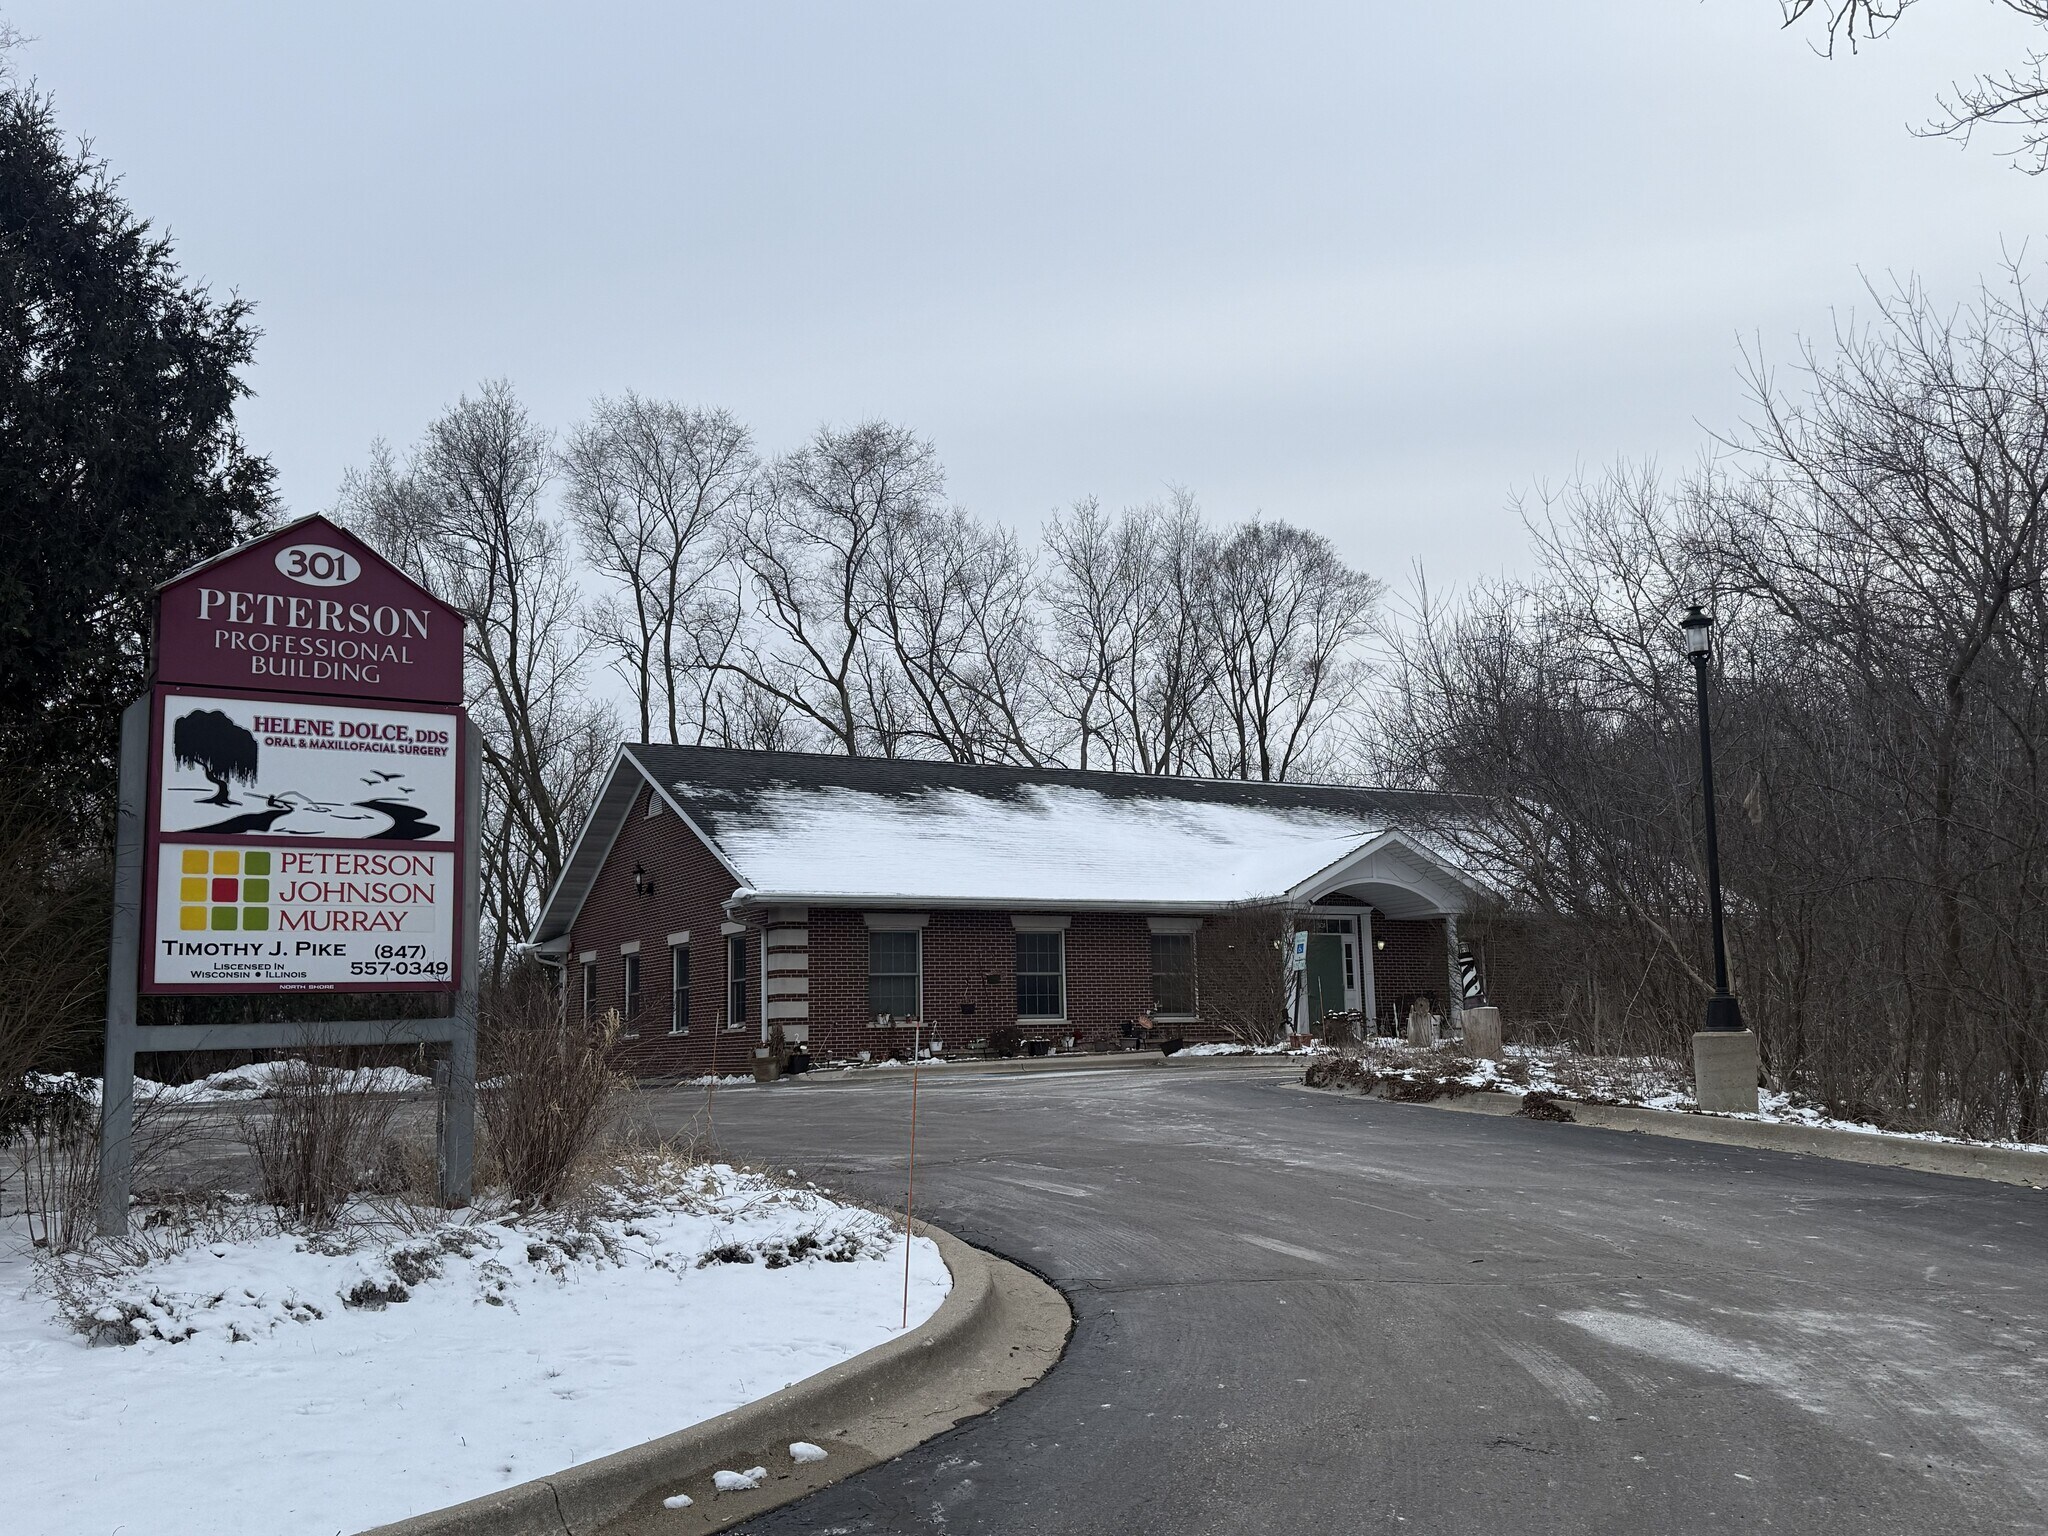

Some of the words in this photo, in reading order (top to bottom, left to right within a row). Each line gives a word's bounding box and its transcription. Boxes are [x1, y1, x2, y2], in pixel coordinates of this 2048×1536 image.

[287, 550, 347, 581] 301
[196, 588, 432, 640] PETERSON
[214, 629, 414, 664] PROFESSIONAL
[251, 655, 381, 684] BUILDING
[253, 716, 335, 737] HELENE
[339, 721, 413, 745] DOLCE,
[415, 729, 449, 744] DDS
[264, 736, 297, 748] ORAL
[299, 738, 308, 749] &
[309, 739, 397, 754] MAXILLOFACIAL
[398, 744, 449, 757] SURGERY
[280, 852, 435, 876] PETERSON
[279, 881, 435, 904] JOHNSON
[278, 909, 409, 932] MURRAY
[161, 940, 264, 956] TIMOTHY
[268, 941, 288, 956] J.
[295, 941, 347, 957] PIKE
[374, 944, 427, 960] (847)
[190, 970, 251, 979] WISCONSIN
[265, 970, 307, 979] ILLINOIS
[213, 962, 272, 971] LISCENSED
[274, 963, 285, 971] IN
[350, 961, 449, 976] 557-0349
